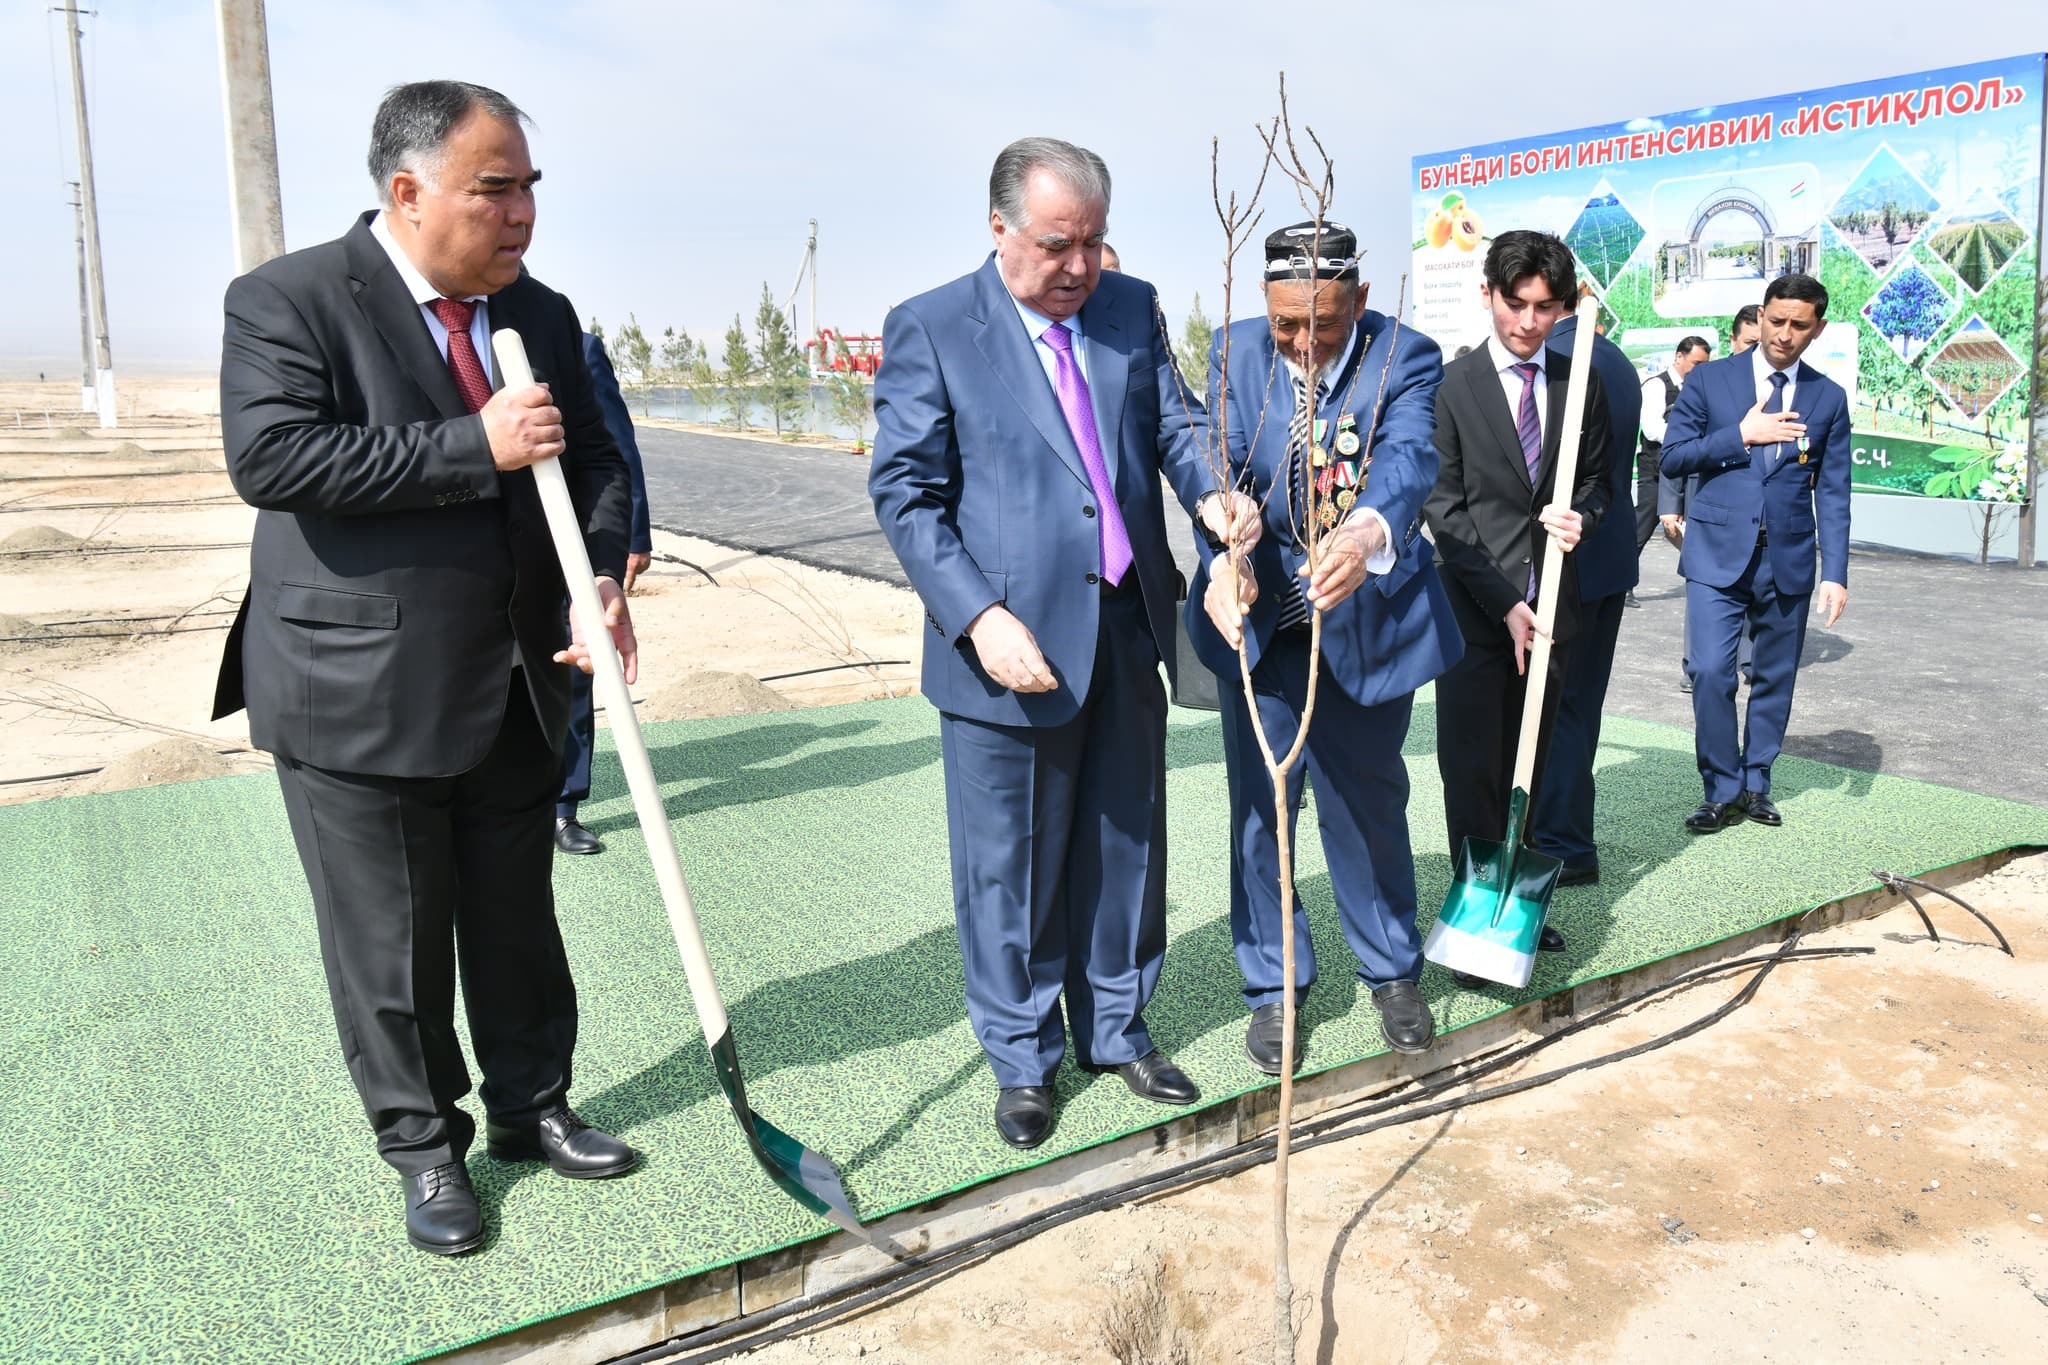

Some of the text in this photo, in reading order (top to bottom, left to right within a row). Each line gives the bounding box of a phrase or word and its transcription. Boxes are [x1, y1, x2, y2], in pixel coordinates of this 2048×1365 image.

[1420, 76, 2026, 191] БУНЁДИ БОҒИ ИНТЕНСИВИИ «ИСТИҚЛОЛ»
